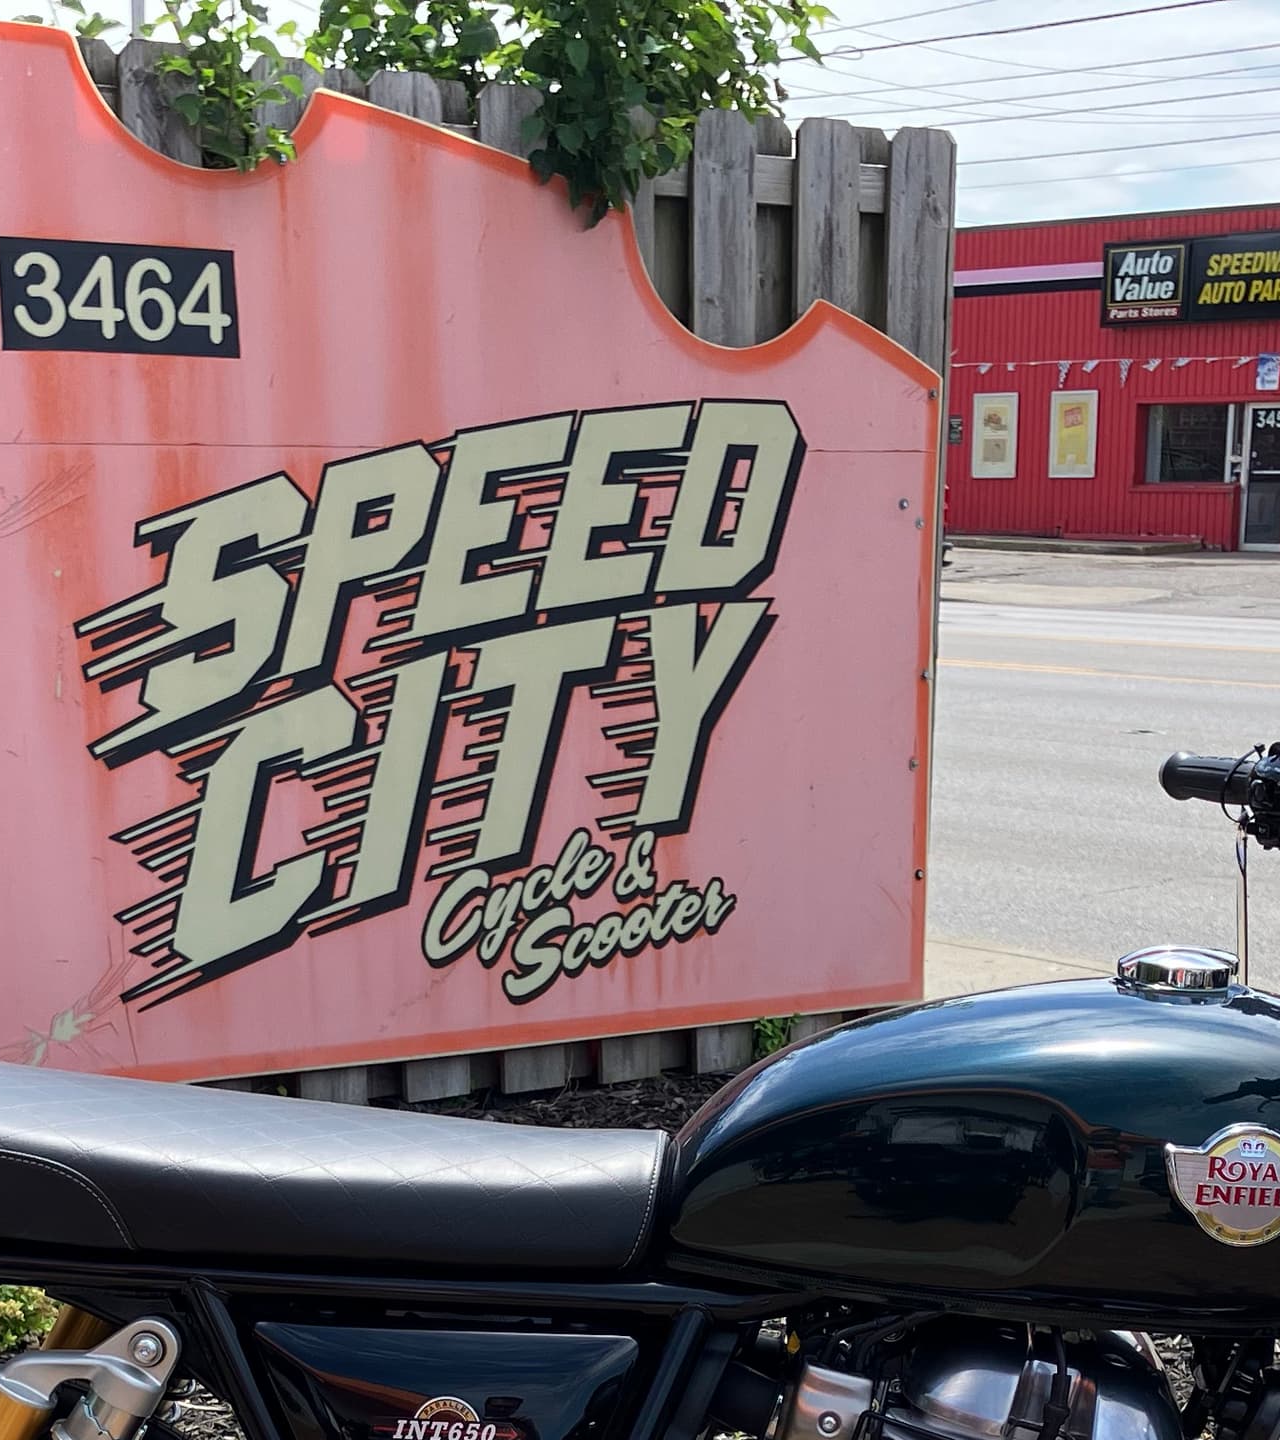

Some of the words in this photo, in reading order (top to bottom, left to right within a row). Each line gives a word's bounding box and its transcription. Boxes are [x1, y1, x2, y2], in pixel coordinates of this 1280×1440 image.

[1114, 277, 1175, 302] Value
[1118, 251, 1175, 276] Auto
[1198, 281, 1246, 304] AUTO
[12, 249, 232, 345] 3464
[1109, 308, 1140, 319] Parts
[1141, 306, 1178, 318] Stores
[74, 398, 807, 767] SPEED
[111, 598, 777, 1012] CITY
[422, 829, 613, 964] Cycle
[620, 831, 657, 892] &
[504, 885, 735, 1003] Scooter
[423, 1400, 471, 1417] PARALLEL
